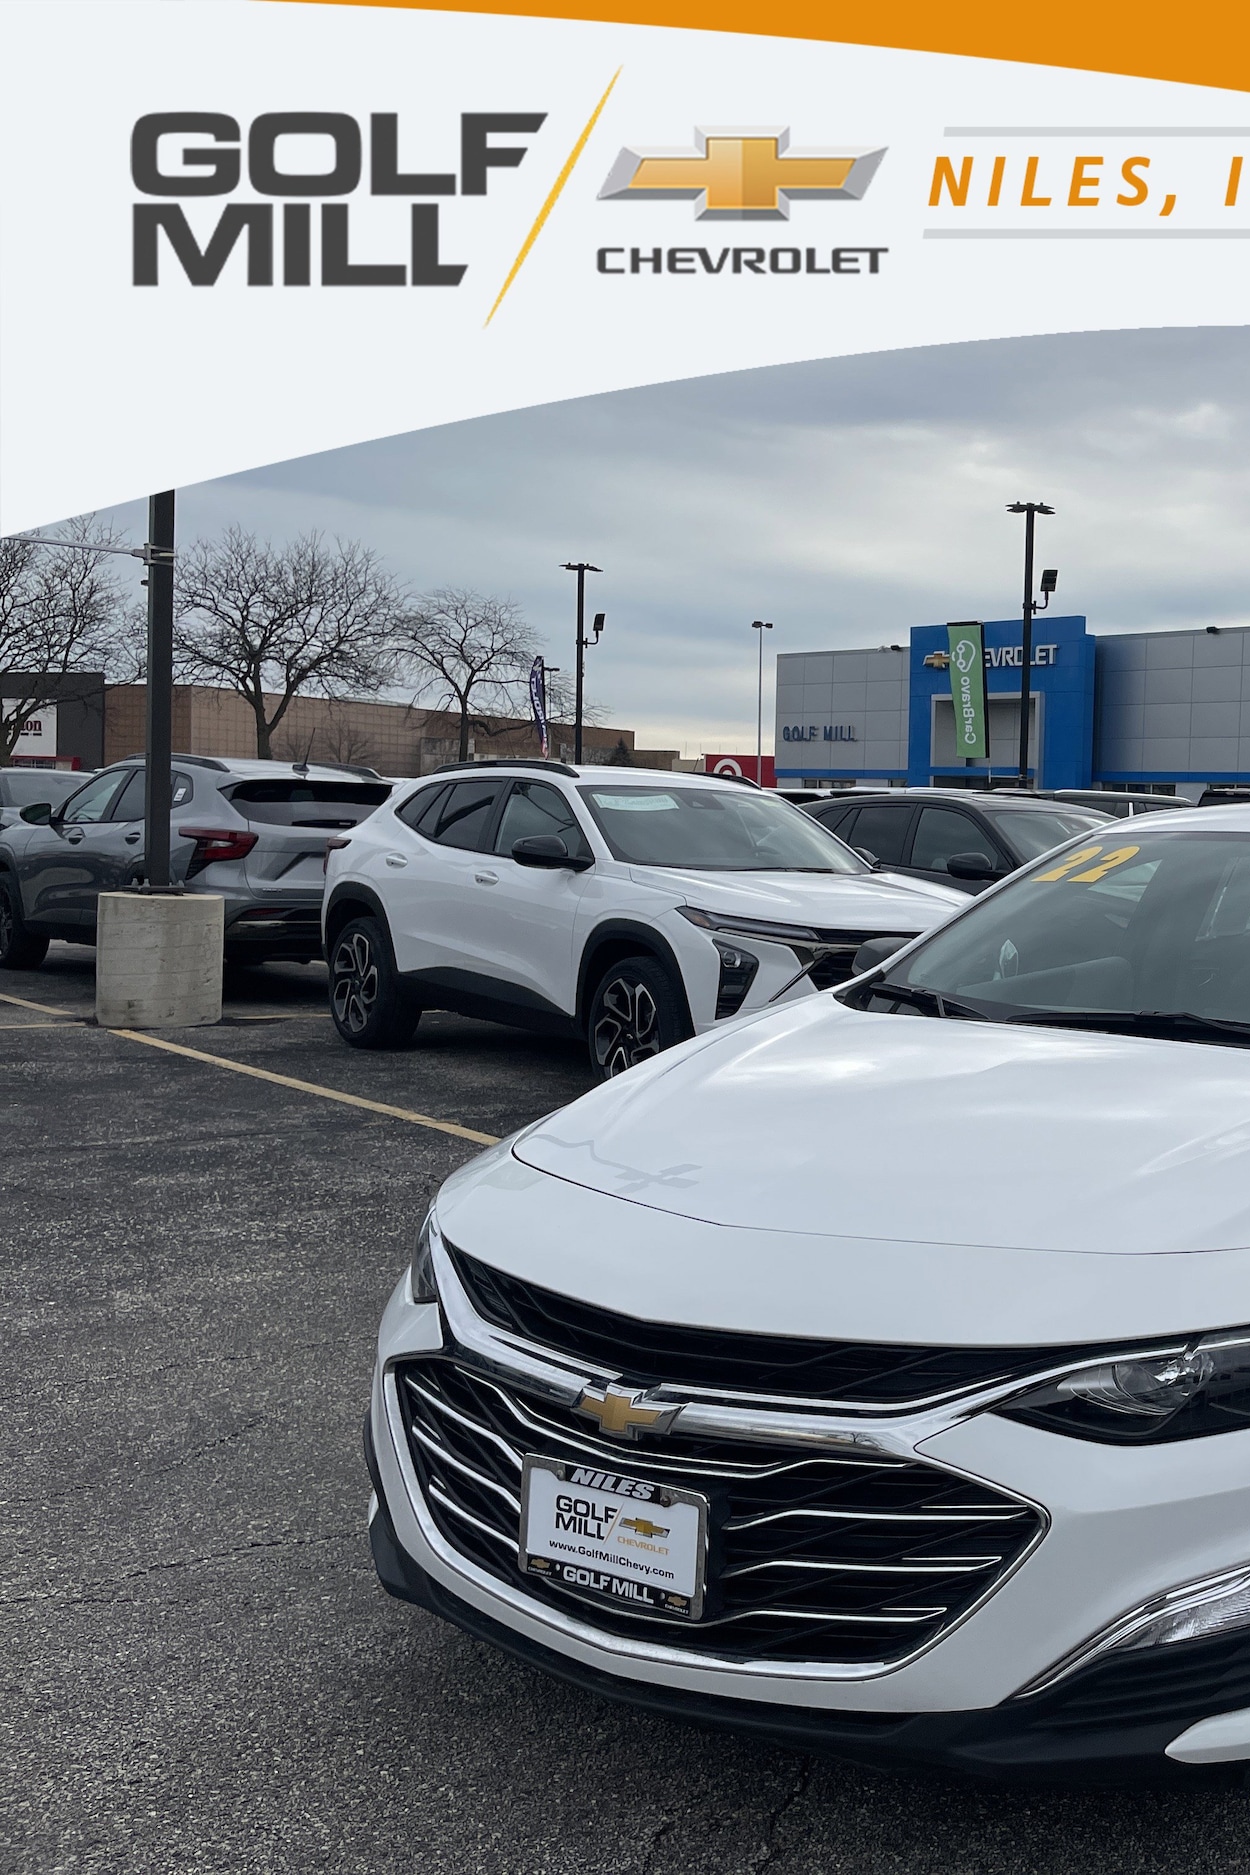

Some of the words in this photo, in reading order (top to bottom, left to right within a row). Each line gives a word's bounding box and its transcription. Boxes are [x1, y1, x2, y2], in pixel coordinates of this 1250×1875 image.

[782, 725, 818, 742] GOLF
[823, 725, 857, 742] MILL
[1031, 845, 1141, 883] 22
[570, 1468, 655, 1500] NILES
[555, 1494, 618, 1524] GOLF
[555, 1512, 605, 1541] MILL
[549, 1539, 675, 1580] www.GolfMillChevy.com
[617, 1535, 669, 1556] CHEVROLET
[563, 1563, 610, 1590] GOLF
[612, 1579, 654, 1605] MILL
